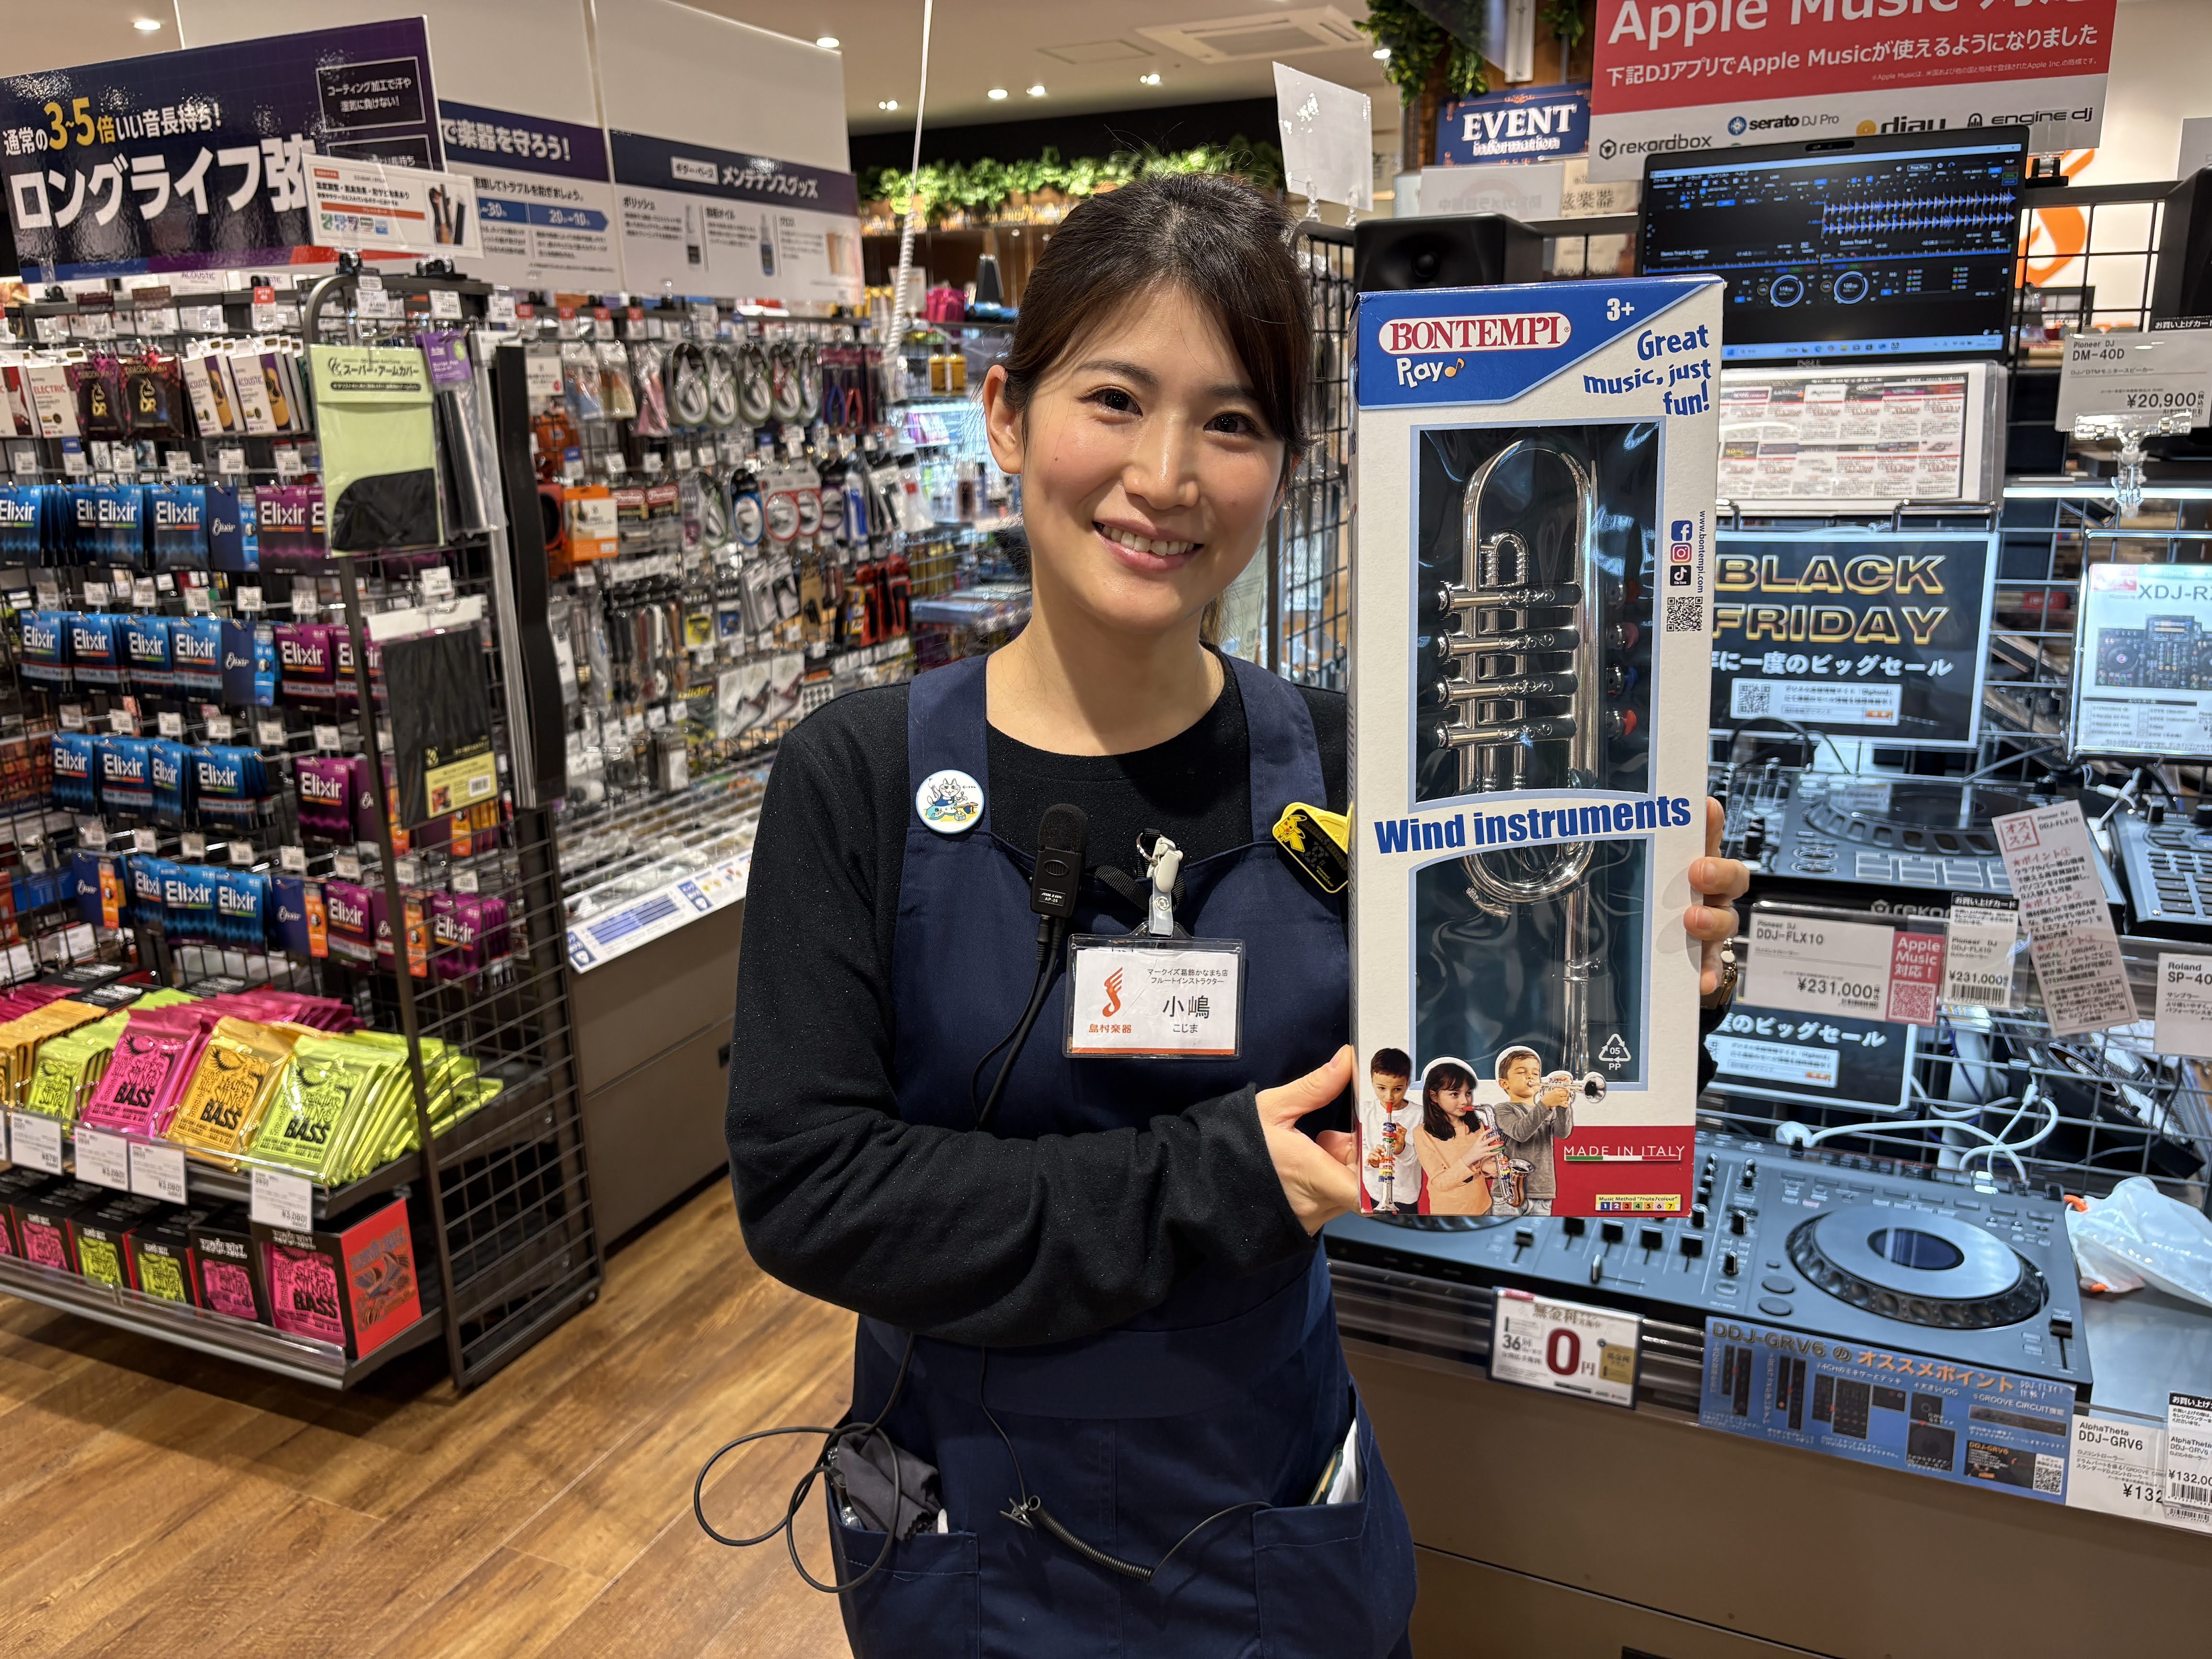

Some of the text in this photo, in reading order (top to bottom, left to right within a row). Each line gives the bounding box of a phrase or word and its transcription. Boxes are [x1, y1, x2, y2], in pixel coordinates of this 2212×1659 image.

[1608, 0, 1767, 51] Apple
[1607, 24, 2098, 87] 下記DJアプリでApple Musicが使えるようになりました
[1461, 103, 1578, 142] EVENT
[1749, 114, 1839, 131] serato DJ Pro
[1991, 107, 2094, 126] engine dj
[441, 118, 572, 161] で楽器を守ろう!
[1473, 134, 1561, 157] information
[1620, 134, 1712, 155] rekordbox
[721, 164, 820, 200] メンテナンスグッズ
[1607, 298, 1635, 321] 3+
[1389, 316, 1562, 351] BONTEMPI
[1637, 324, 1710, 361] Great
[2072, 349, 2125, 362] DM-40D
[1397, 357, 1444, 389] Play
[1583, 359, 1711, 394] music, just
[33, 384, 67, 395] ELECTRIC
[1663, 379, 1710, 416] fun!
[2127, 392, 2196, 408] ¥20,900
[91, 401, 108, 417] DR
[139, 398, 158, 413] DR
[0, 499, 35, 522] Elixir
[76, 498, 96, 521] Eli
[98, 499, 137, 523] Elixir
[156, 500, 200, 524] Elixir
[261, 501, 306, 525] Elixir
[1696, 511, 1707, 593] www.bontempi.com
[1715, 554, 1947, 595] BLACK
[1712, 602, 1950, 645] FRIDAY
[23, 624, 55, 649] Elixir
[73, 627, 109, 651] Elixir
[128, 630, 164, 655] Elixir
[175, 632, 216, 658] Elixir
[280, 641, 324, 666] Elixir
[54, 747, 87, 771] Elixir
[103, 753, 144, 777] Elixir
[152, 758, 178, 784] Elixir
[198, 762, 238, 787] Elixir
[299, 772, 342, 799] Elixir
[1374, 795, 1692, 854] Wind instruments
[135, 869, 161, 896] Elixi
[164, 881, 213, 905] Elixir
[219, 885, 257, 912] Elixir
[328, 898, 363, 924] Elixir
[1756, 928, 1824, 946] DDJ-FLX10
[1897, 937, 1940, 954] Apple
[1895, 950, 1938, 966] Music
[2168, 961, 2201, 972] Roland
[1147, 968, 1229, 977] マークイズ葛飾かなまち店
[1151, 976, 1224, 985] フルートインストラクター
[1949, 970, 2003, 985] ¥231,000
[1798, 977, 1873, 999] ¥231,000
[1162, 995, 1210, 1019] 小嶋
[1088, 1023, 1132, 1034] 島村楽器
[1173, 1023, 1198, 1033] こじま
[1609, 1047, 1621, 1055] 05
[113, 1081, 156, 1108] BASS
[200, 1099, 243, 1131] BASS
[284, 1119, 332, 1145] BASS
[1564, 1145, 1686, 1157] MADE IN ITALY
[293, 1291, 338, 1319] BASS
[1712, 1322, 2015, 1393] DDJ-GRV6 の オススメポイント
[1978, 1393, 2014, 1407] GROOVE
[2078, 1430, 2144, 1451] DDJ-GRV6
[2079, 1421, 2129, 1437] AlphaTheta
[2170, 1443, 2209, 1455] DDJ-GRV6
